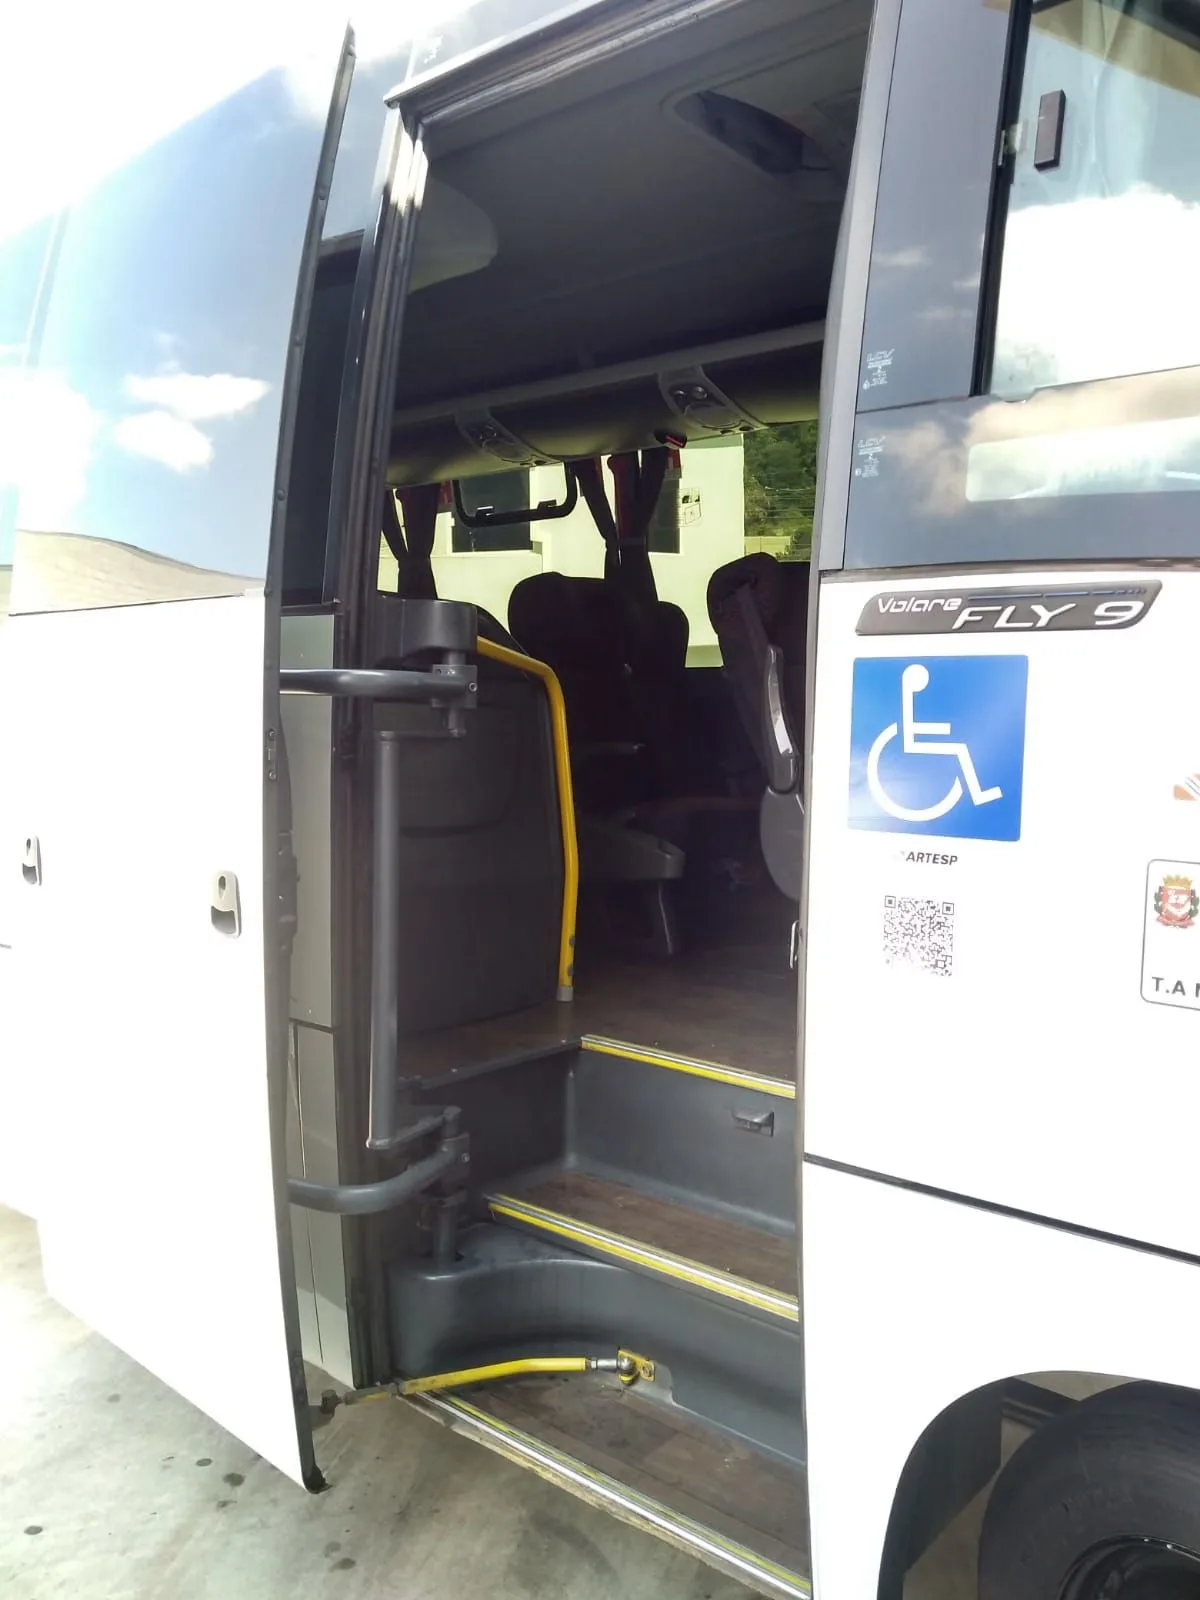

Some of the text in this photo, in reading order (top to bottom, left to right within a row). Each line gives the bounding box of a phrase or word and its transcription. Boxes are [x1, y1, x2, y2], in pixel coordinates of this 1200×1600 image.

[877, 598, 1144, 630] Volare FLY 9
[906, 851, 958, 865] ARTESP
